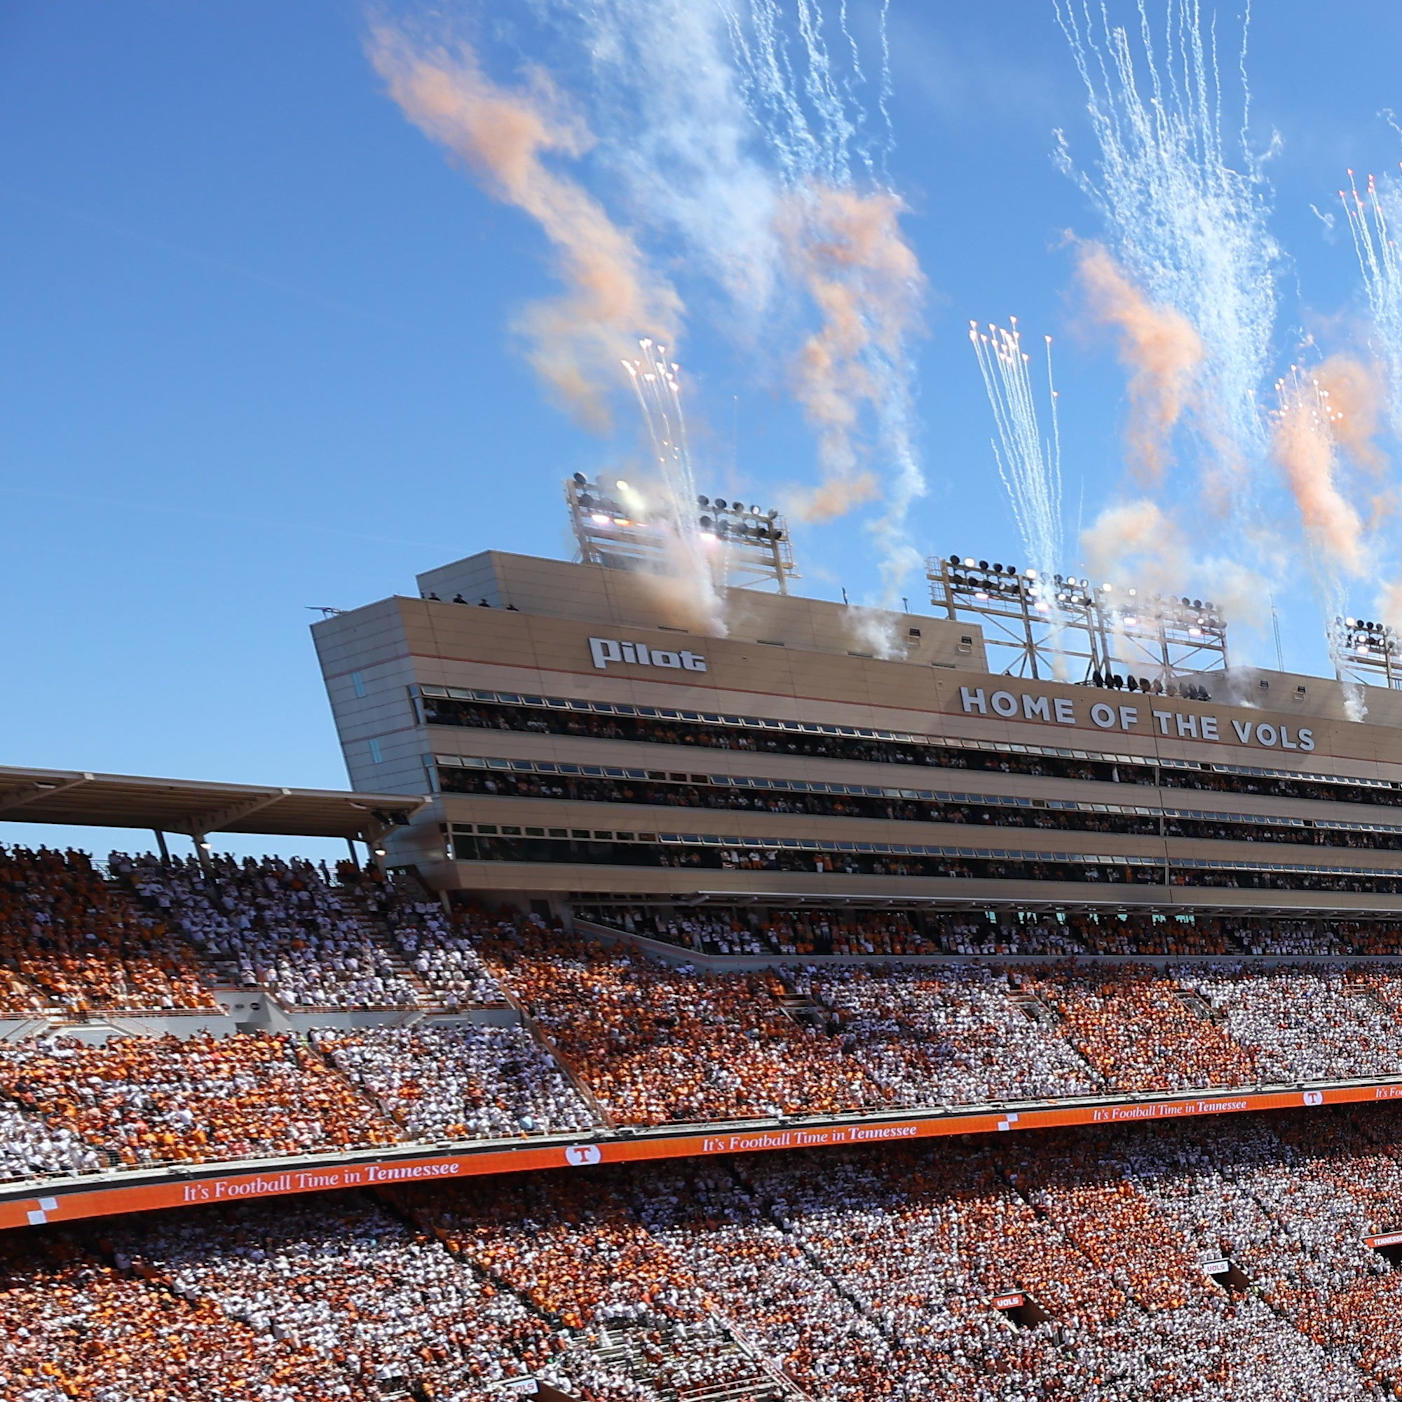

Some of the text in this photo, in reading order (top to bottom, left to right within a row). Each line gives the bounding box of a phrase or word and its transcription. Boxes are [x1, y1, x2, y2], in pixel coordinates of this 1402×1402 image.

[960, 685, 1316, 752] HOME OF THE VOLS
[1375, 1088, 1387, 1098] It's
[1093, 1100, 1247, 1120] It's Football Time in Tennessee
[703, 1126, 917, 1151] It's Football Time in Tennessee
[184, 1162, 459, 1201] It's Football Time in Tennessee
[996, 1297, 1019, 1307] VOLS
